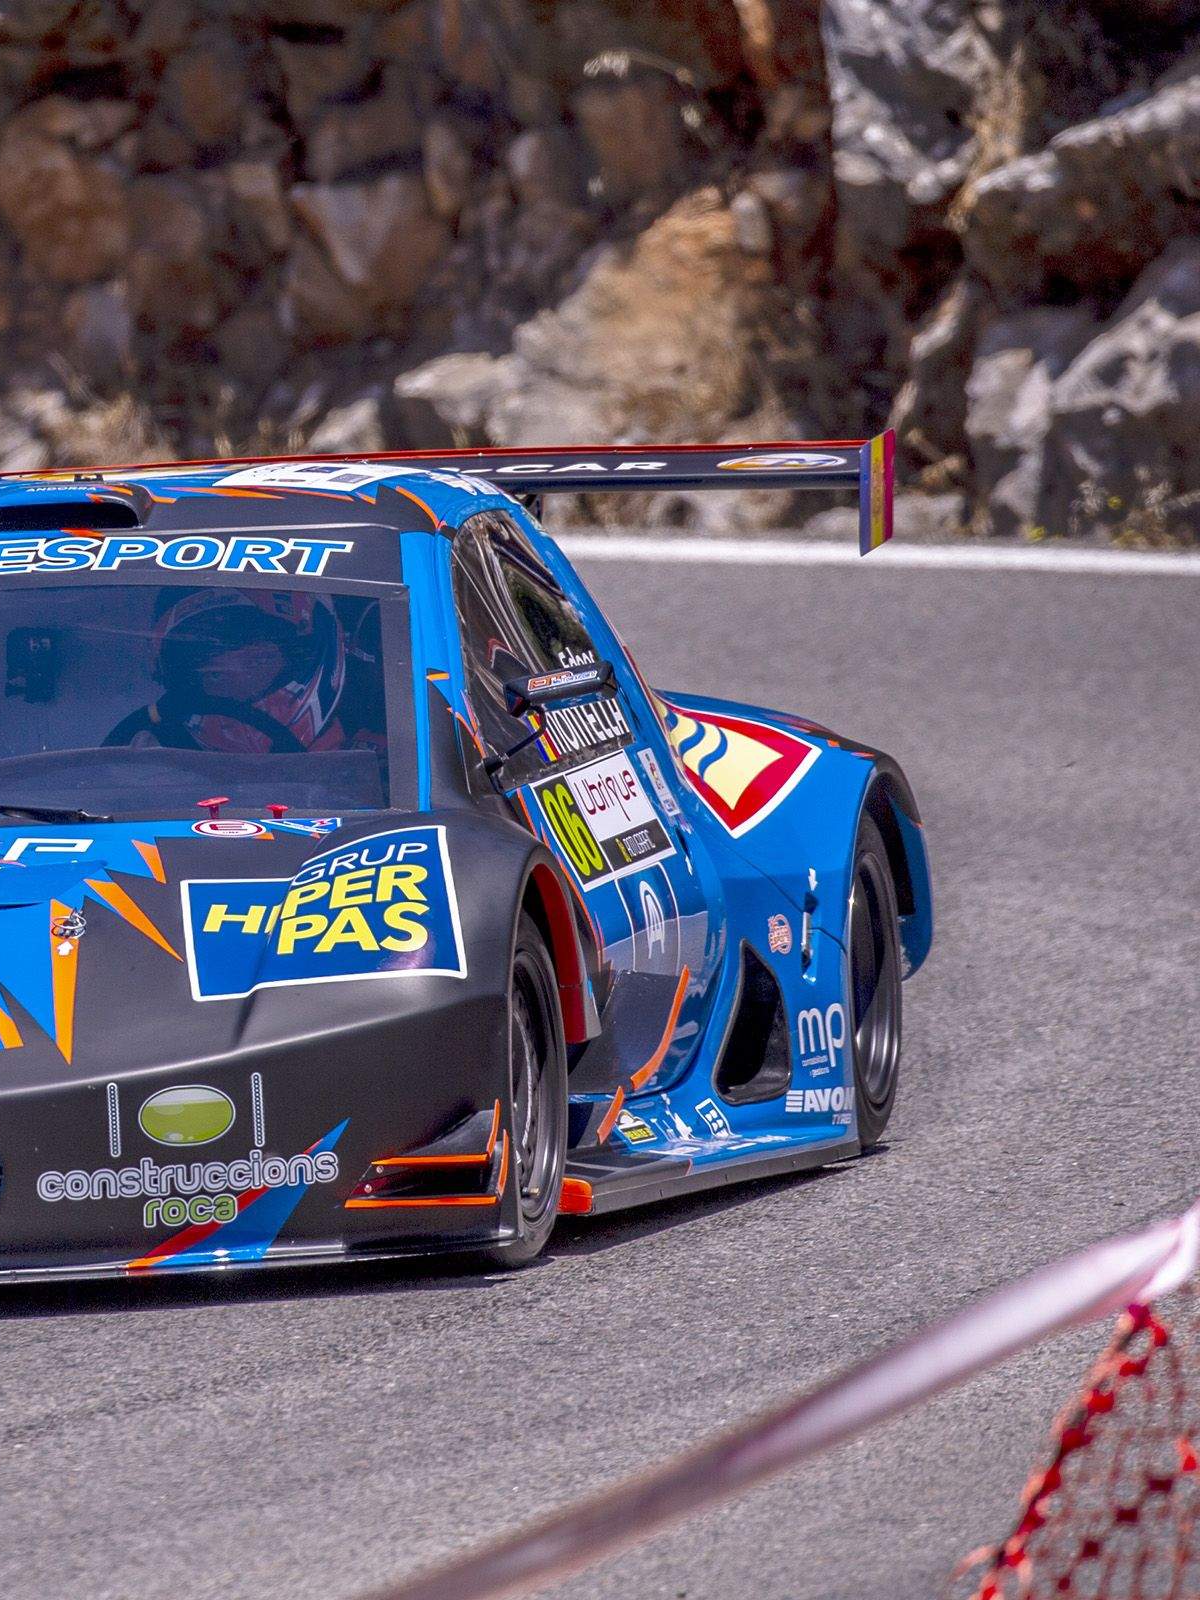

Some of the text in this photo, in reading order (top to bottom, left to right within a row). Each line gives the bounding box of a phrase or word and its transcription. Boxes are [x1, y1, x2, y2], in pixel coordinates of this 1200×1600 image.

[573, 770, 637, 822] Ubrique
[542, 783, 603, 876] 06
[291, 843, 428, 886] GRUP
[277, 901, 430, 955] PAS
[798, 1003, 846, 1067] mp
[803, 1086, 856, 1112] AVON
[37, 1150, 339, 1202] construccions
[143, 1194, 239, 1228] roca
